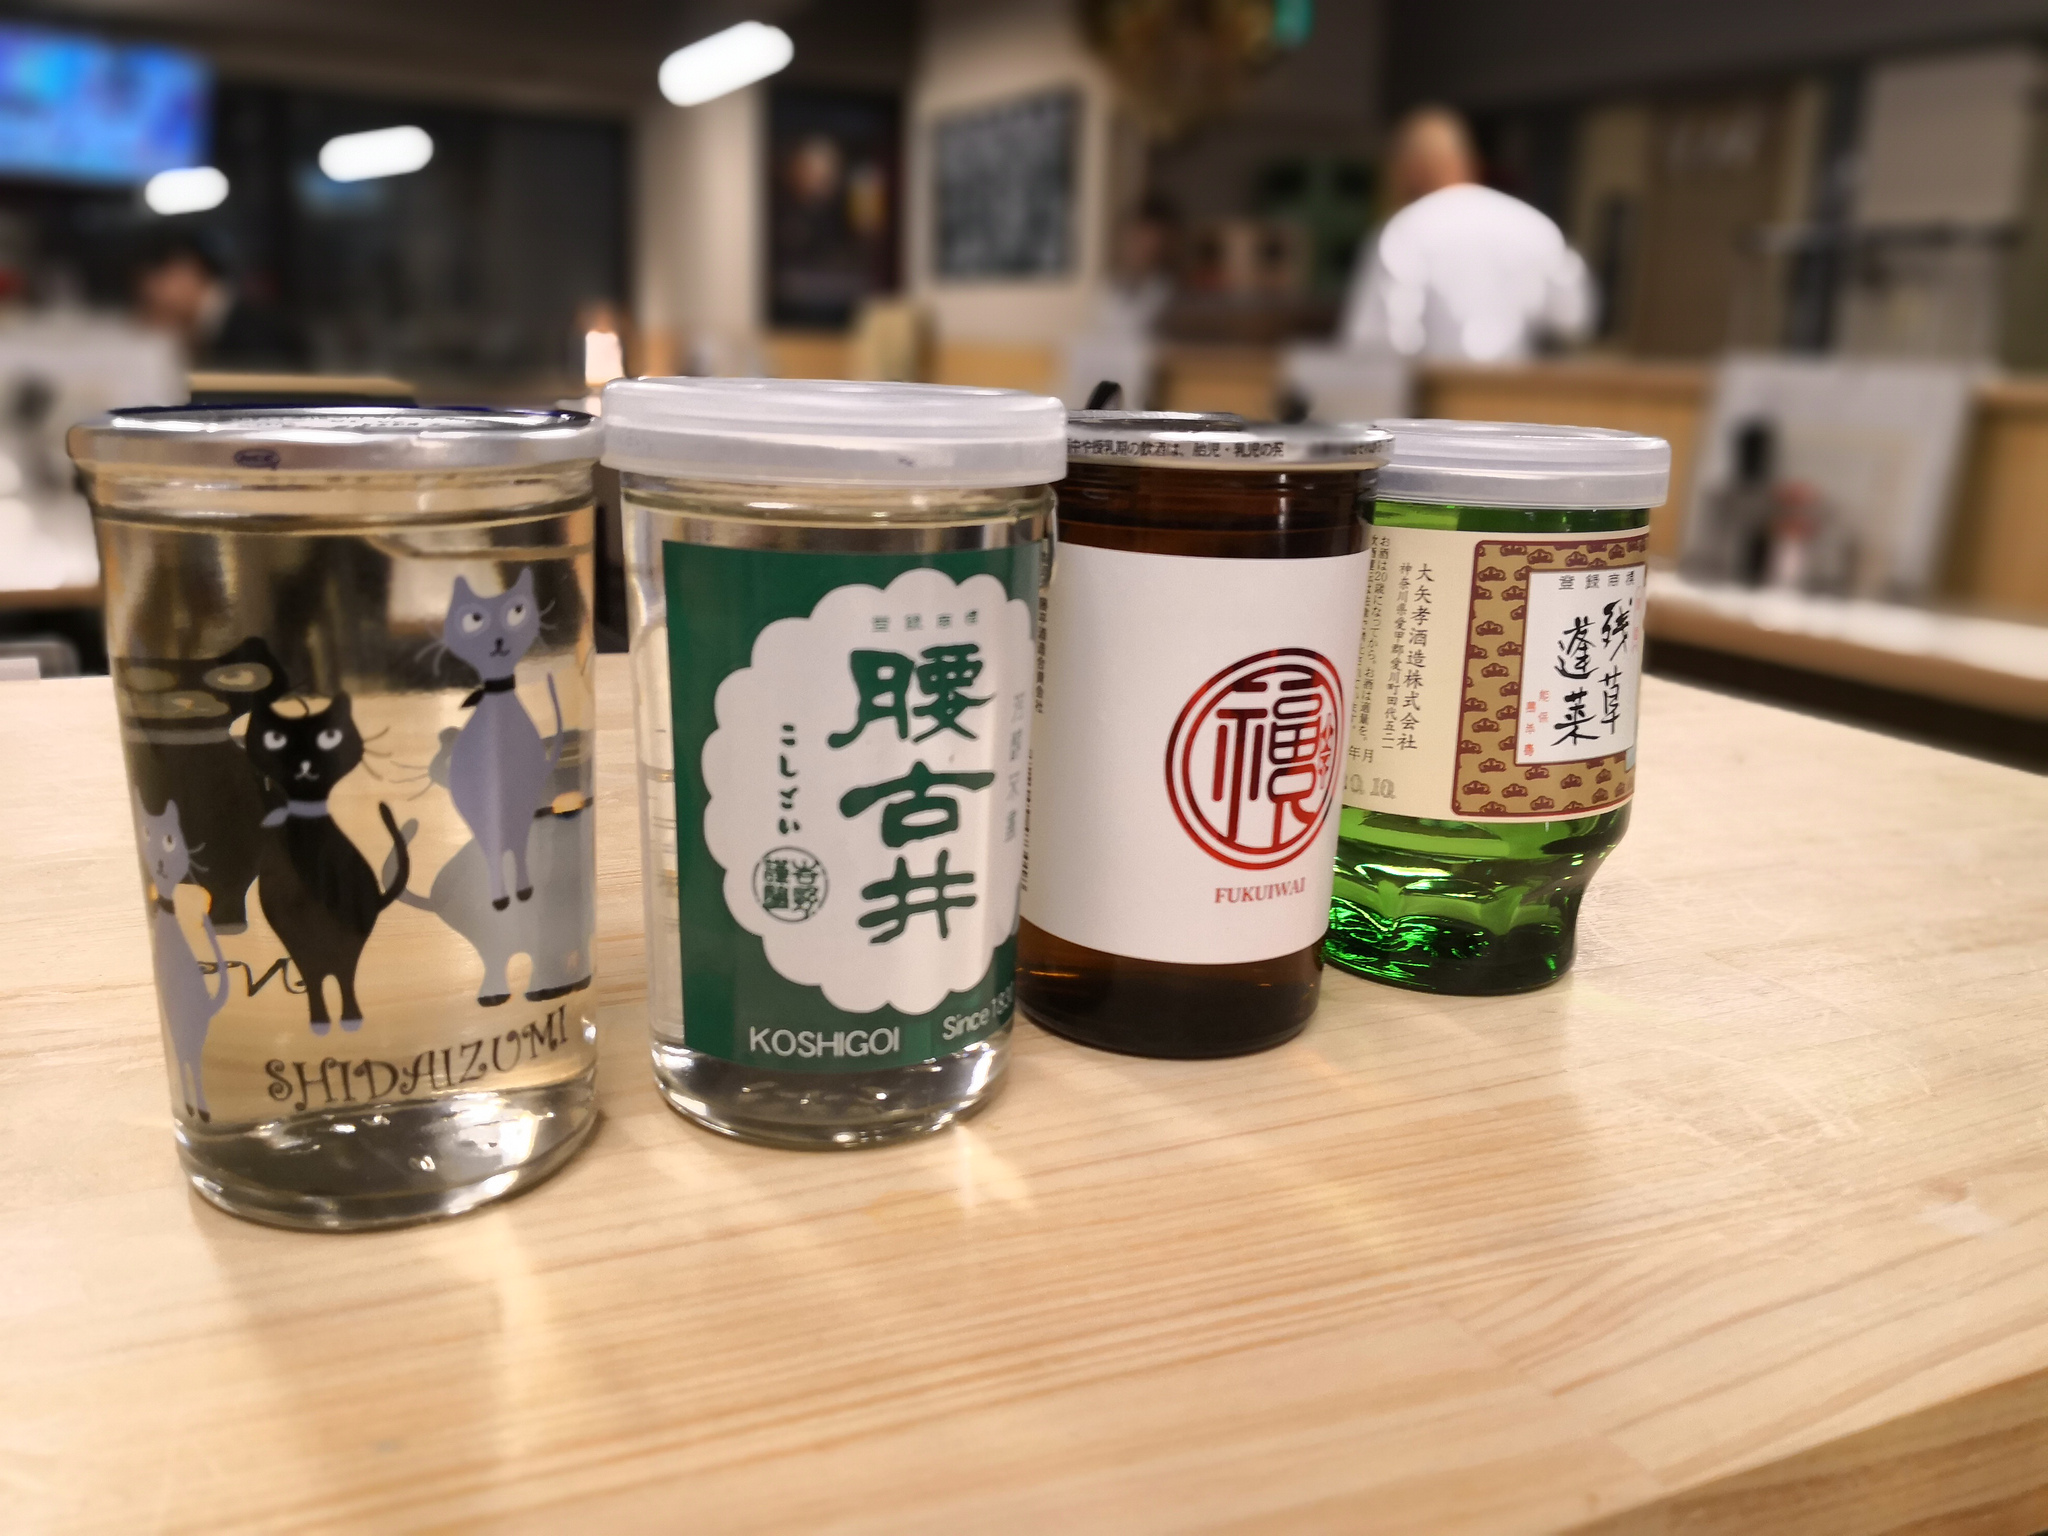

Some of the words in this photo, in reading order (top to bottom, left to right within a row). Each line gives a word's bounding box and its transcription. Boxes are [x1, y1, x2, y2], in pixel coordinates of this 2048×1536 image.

[1396, 563, 1434, 750] 大矢孝酒造株式会社
[827, 643, 995, 944] 腰古井
[1214, 877, 1306, 903] FUKUIWAI
[265, 1004, 569, 1111] SHIDAIZUMI
[749, 1025, 900, 1058] KOSHIGOI
[942, 1008, 989, 1041] Since
